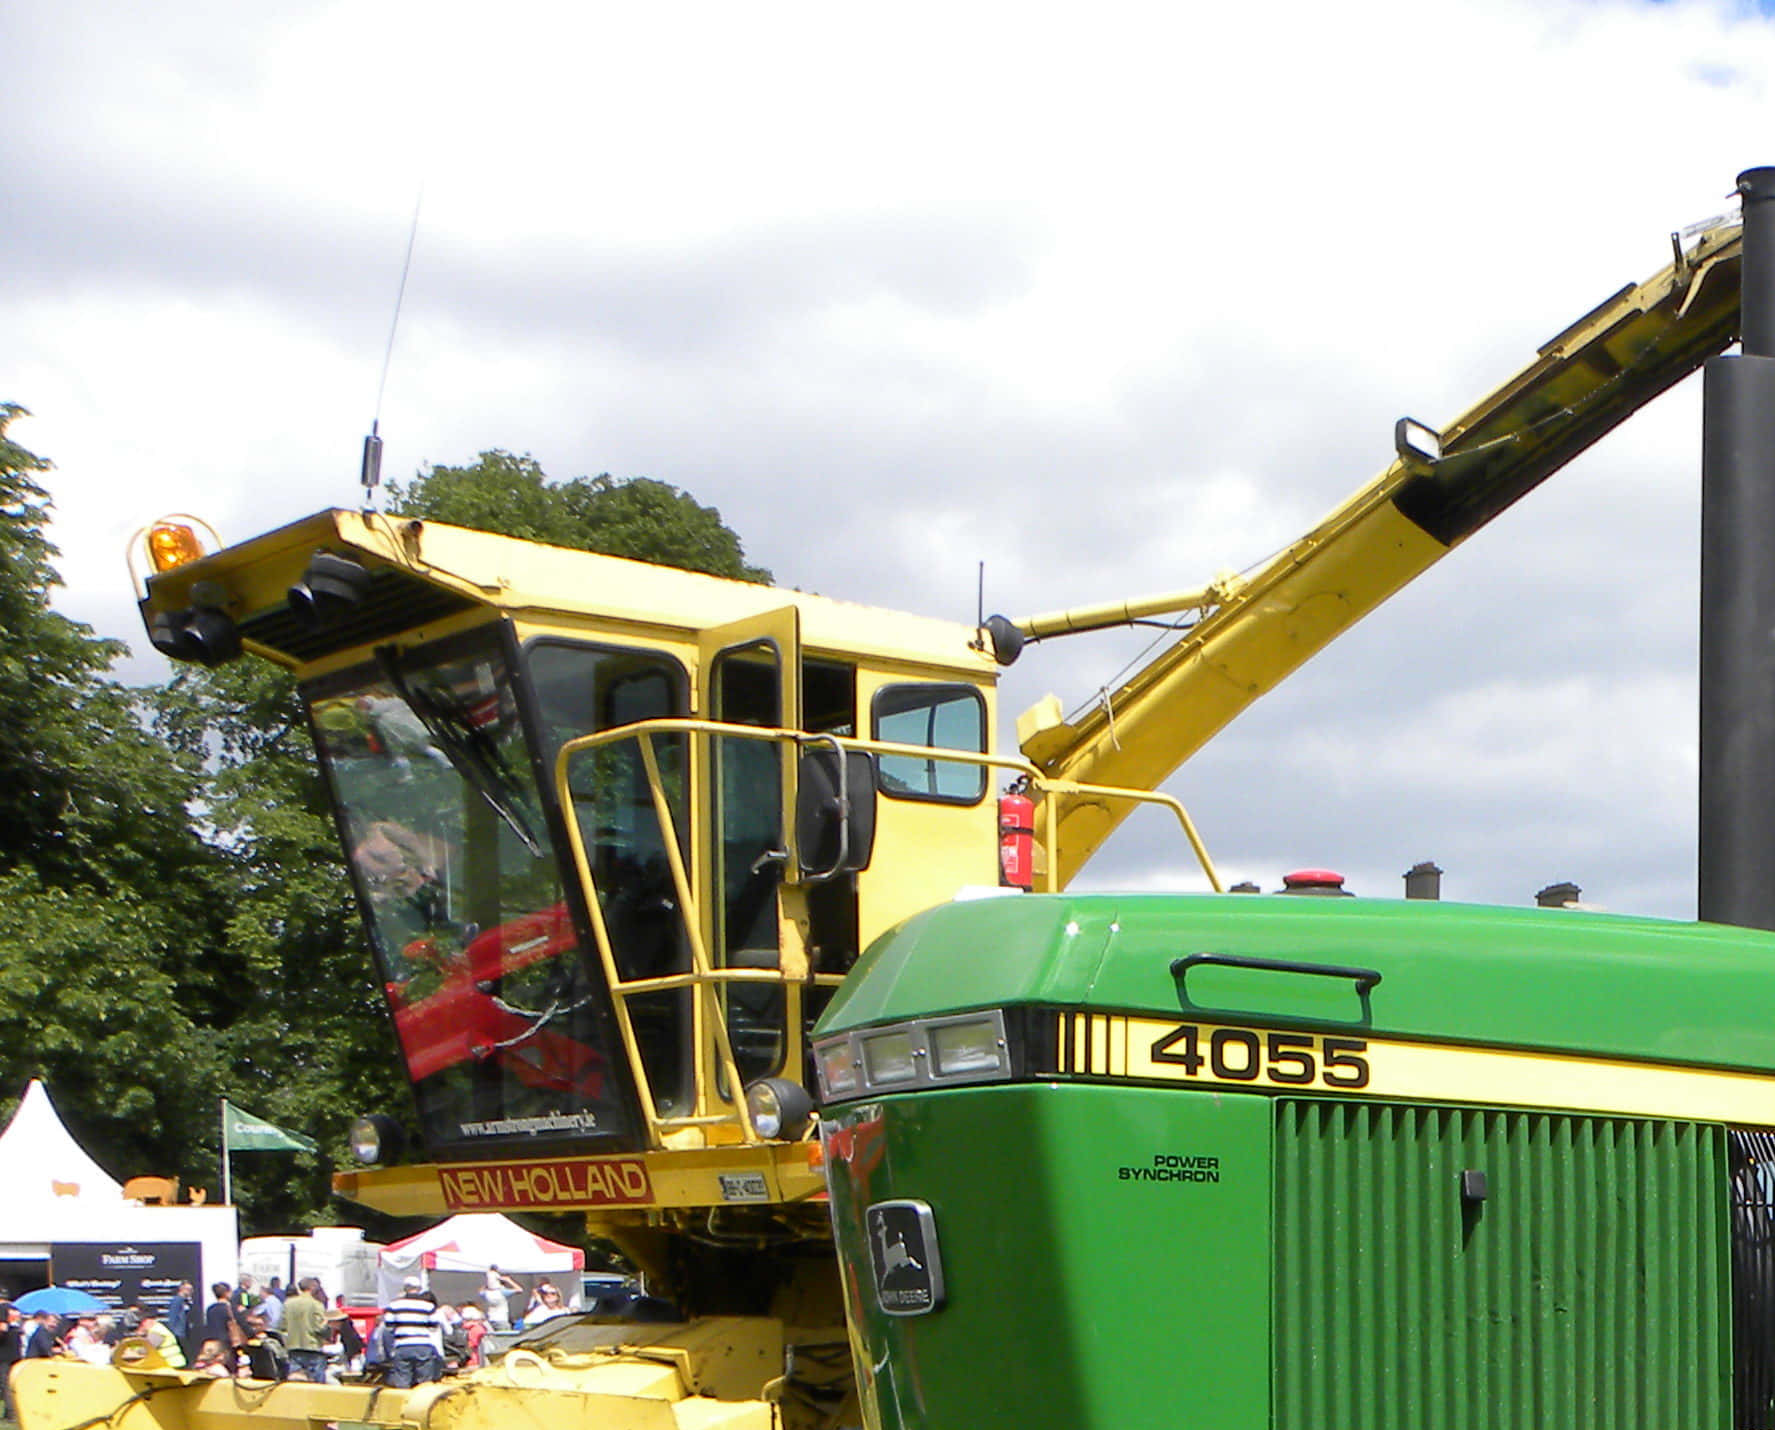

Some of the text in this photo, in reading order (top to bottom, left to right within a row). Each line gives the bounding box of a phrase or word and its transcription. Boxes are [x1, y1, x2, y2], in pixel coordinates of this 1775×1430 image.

[1150, 1025, 1370, 1089] 4055
[1118, 1168, 1219, 1183] SYNCHRON
[1154, 1155, 1219, 1168] POWER
[443, 1162, 648, 1204] NEW HOLLAND
